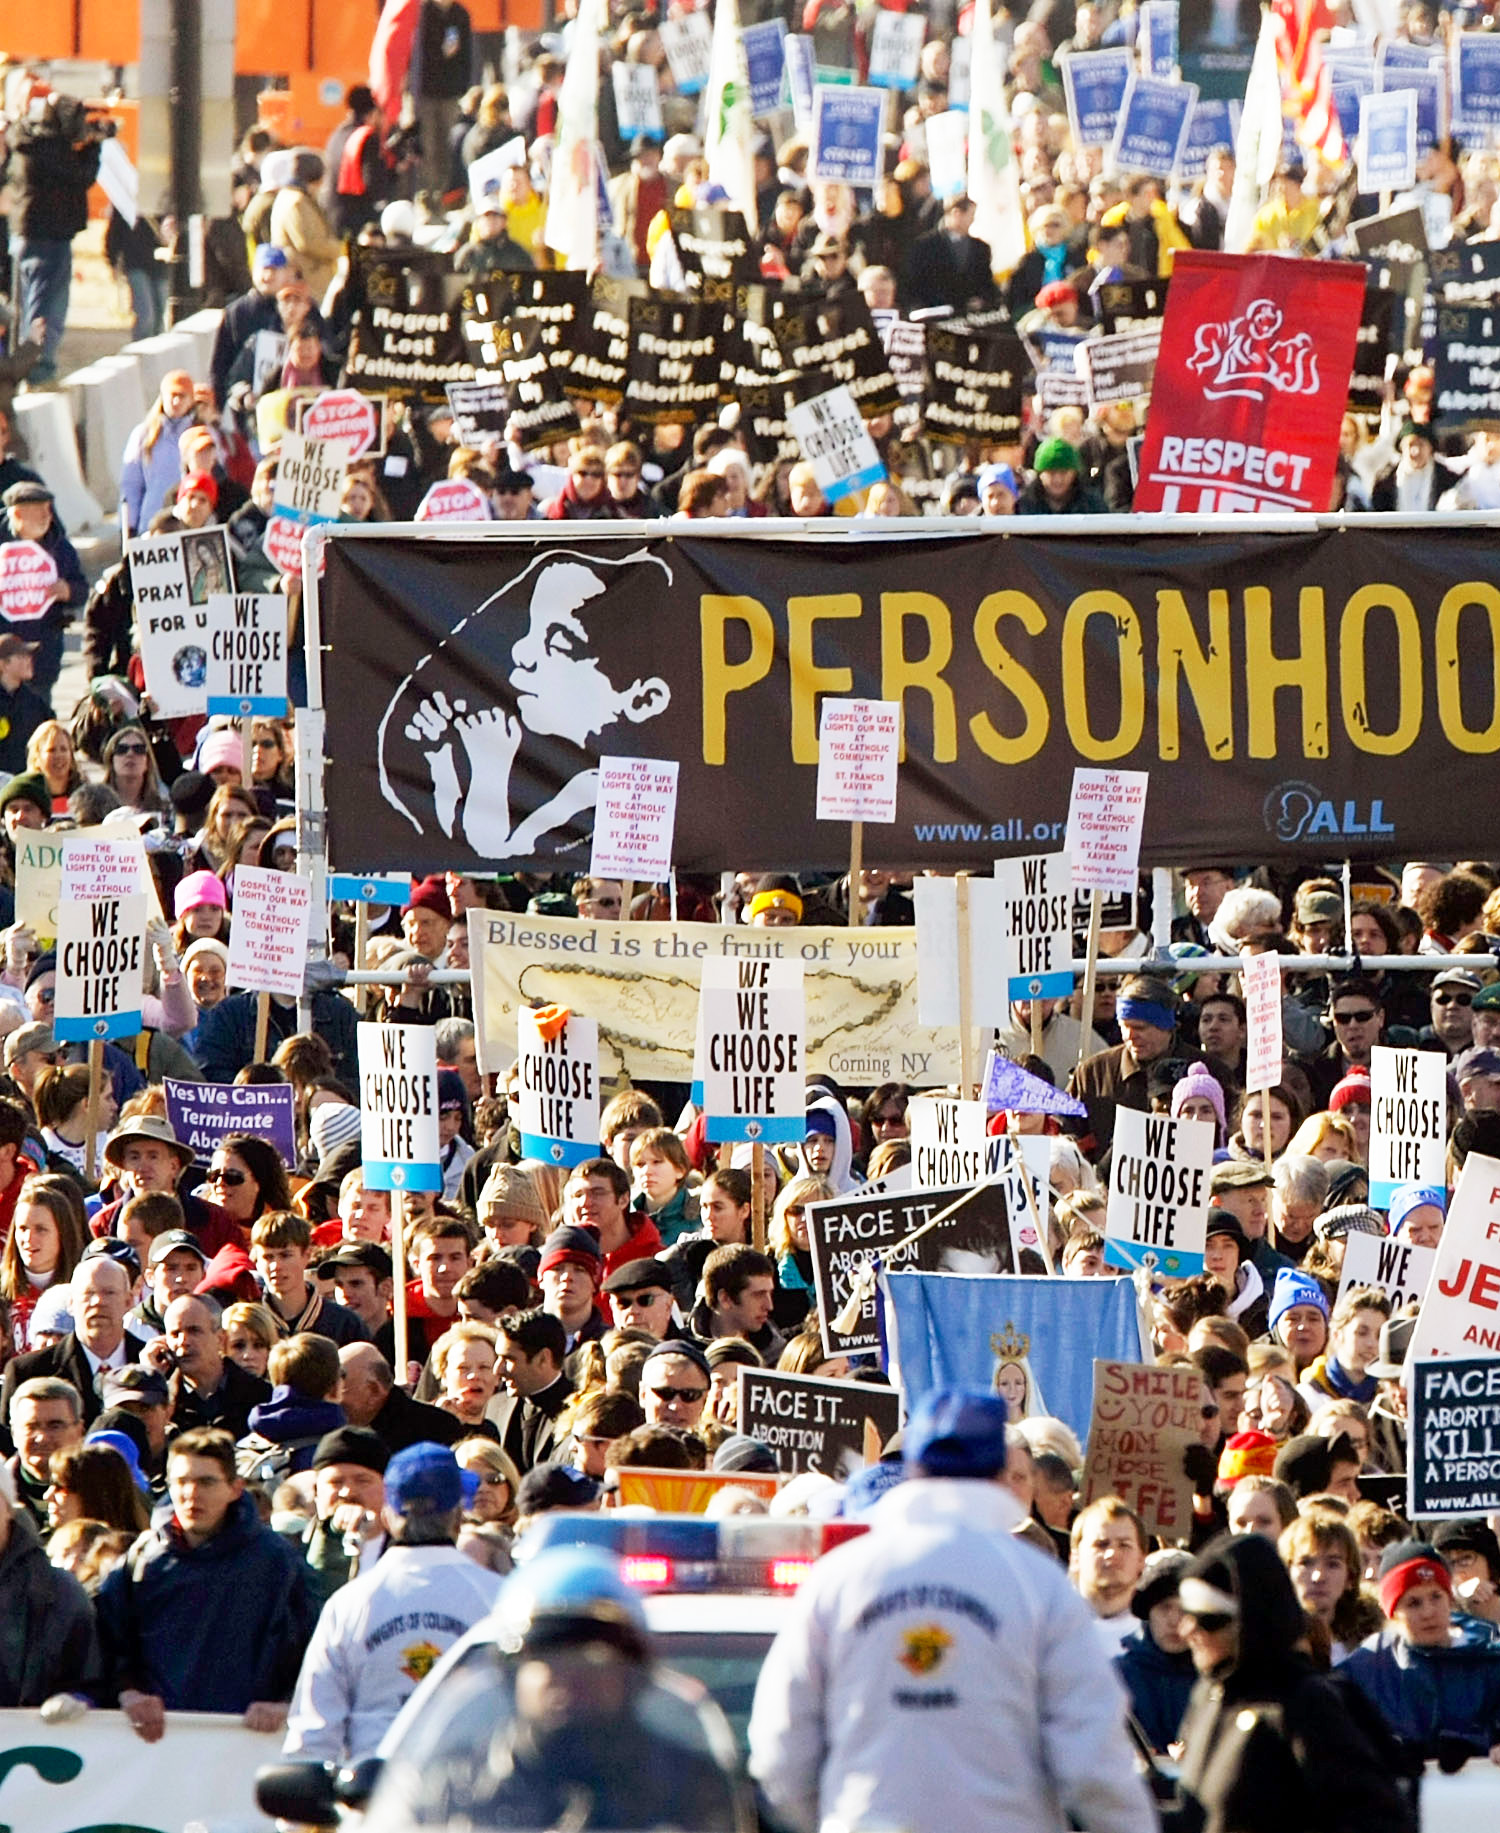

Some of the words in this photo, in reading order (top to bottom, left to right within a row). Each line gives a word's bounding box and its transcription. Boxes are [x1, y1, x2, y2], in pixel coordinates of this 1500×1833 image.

[372, 307, 450, 333] Regret
[384, 333, 435, 357] Lost
[638, 332, 714, 359] Regret
[625, 381, 720, 403] Abortion
[316, 401, 362, 422] STOP
[1158, 436, 1311, 491] RESPECT
[429, 494, 479, 515] STOP
[134, 546, 179, 566] MARY
[139, 583, 183, 602] PRAY
[150, 616, 185, 634] FOR
[195, 613, 206, 628] U
[235, 599, 259, 627] WE
[212, 631, 280, 661] CHOOSE
[229, 664, 262, 694] LIFE
[602, 782, 631, 790] LIGHTS
[605, 771, 636, 780] GOSPEL
[655, 775, 671, 783] LIFE
[606, 801, 620, 809] THE
[625, 802, 666, 813] CATHOLIC
[1307, 801, 1395, 833] ALL
[625, 832, 659, 842] FRANCIS
[914, 820, 1068, 843] www.all.or
[92, 901, 120, 938] WE
[486, 920, 598, 954] Blessed
[610, 930, 642, 956] is
[652, 934, 708, 958] the
[722, 935, 784, 959] fruit
[800, 938, 832, 961] of
[848, 940, 901, 965] your
[64, 936, 140, 977] CHOOSE
[83, 976, 119, 1014] LIFE
[736, 994, 769, 1030] WE
[710, 1034, 798, 1074] CHOOSE
[828, 1052, 890, 1078] Corning
[901, 1054, 931, 1075] NY
[168, 1082, 195, 1102] Yes
[199, 1088, 227, 1105] We
[236, 1086, 288, 1105] Can...
[732, 1076, 776, 1114] LIFE
[181, 1107, 274, 1128] Terminate
[1145, 1119, 1177, 1161] WE
[1117, 1154, 1203, 1207] CHOOSE
[823, 1209, 893, 1243] FACE
[1132, 1202, 1177, 1248] LIFE
[1104, 1364, 1199, 1399] SMILE
[1425, 1462, 1439, 1483] A
